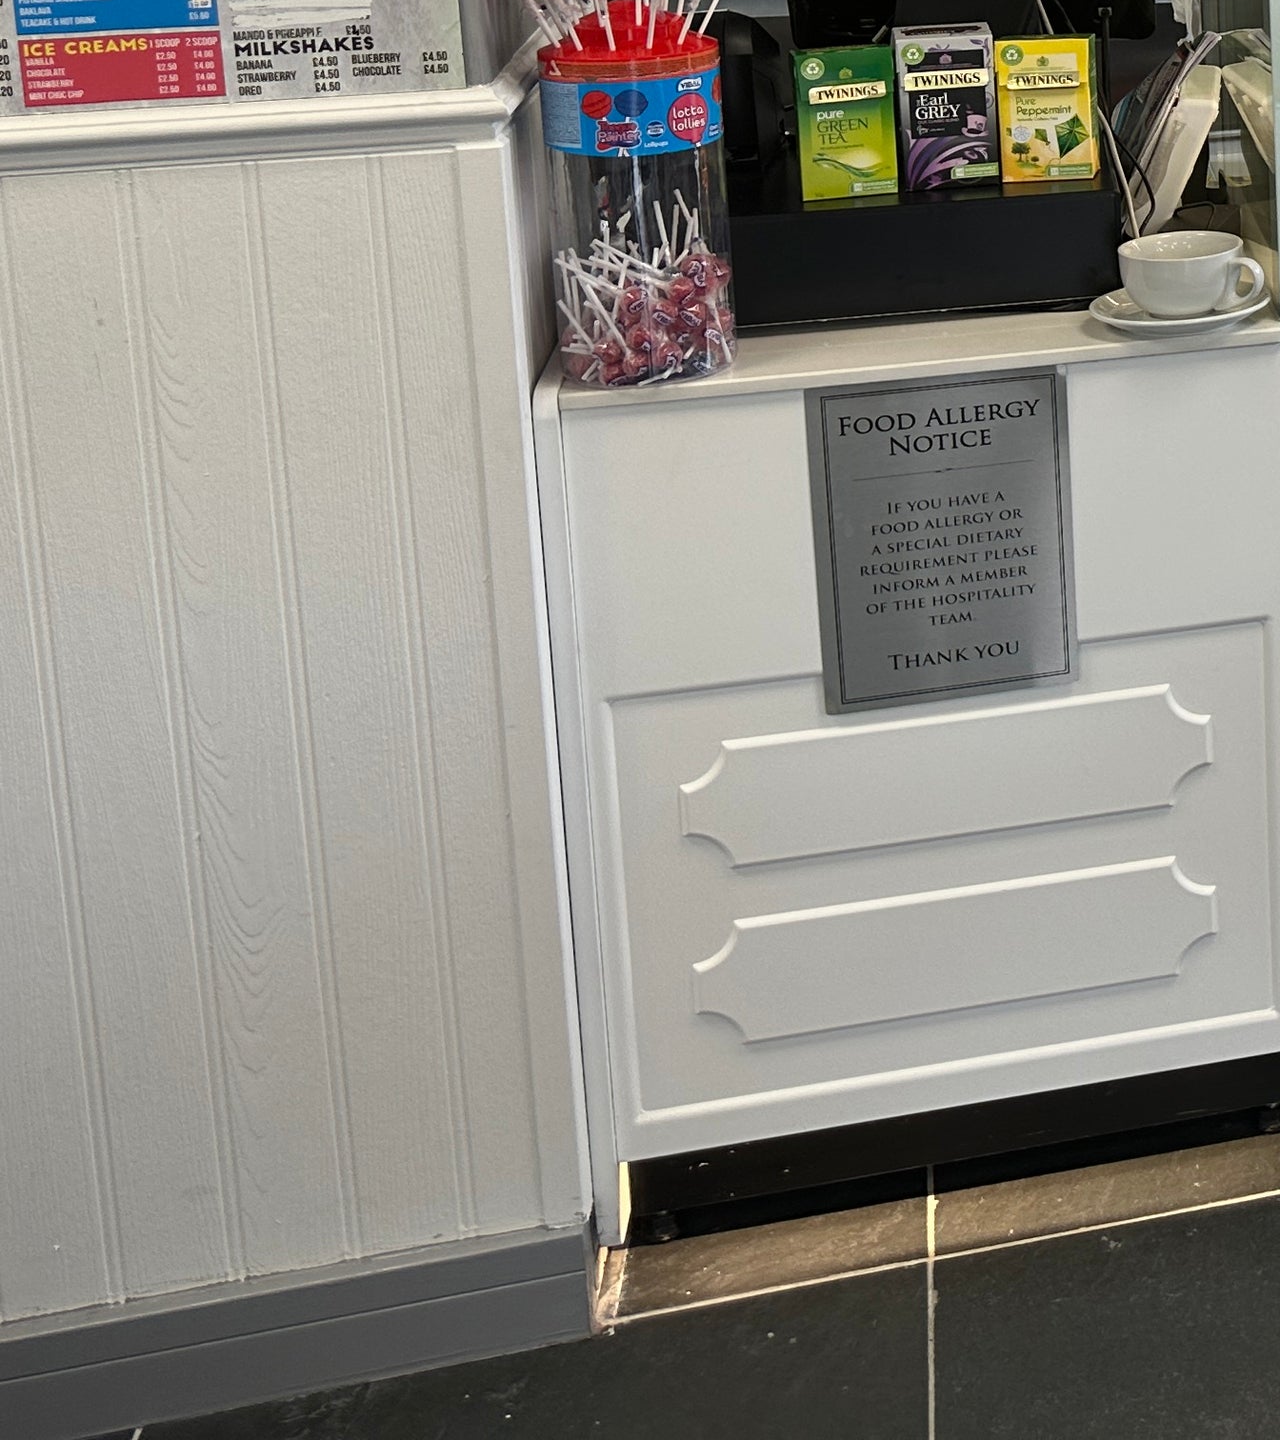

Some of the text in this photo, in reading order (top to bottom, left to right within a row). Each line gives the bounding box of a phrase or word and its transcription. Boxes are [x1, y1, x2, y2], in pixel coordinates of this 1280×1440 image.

[23, 38, 148, 57] ICE CREAMS
[234, 36, 374, 57] MILKSHAKES
[237, 56, 338, 71] BANANA £4.50
[352, 53, 401, 65] BLUEBERRY
[237, 69, 340, 84] STRAWBERRY £4.50
[353, 64, 448, 78] CHOCOLATE £4.50
[911, 72, 981, 87] TWININGS
[1013, 76, 1073, 86] TWININGS
[816, 85, 879, 101] TWININGS
[919, 92, 948, 106] Earl
[1015, 97, 1036, 106] Pure
[673, 106, 704, 119] lotta
[817, 109, 844, 120] pure
[915, 104, 960, 120] GREY
[1016, 105, 1072, 117] Peppermint
[673, 118, 705, 131] lollies
[817, 118, 868, 133] GREEN
[817, 131, 847, 145] TEA
[838, 399, 1041, 437] FOOD ALLERGY
[889, 429, 992, 457] NOTICE
[907, 498, 942, 512] YOU
[949, 494, 987, 507] HAVE
[990, 491, 1004, 503] A
[872, 508, 1023, 536] FOOD ALLERGY OR
[871, 528, 1024, 556] A SPECIAL DIETARY
[860, 545, 1038, 577] REQUIREMENT PLEASE
[873, 565, 1028, 595] INFORM A MEMBER
[866, 584, 1036, 615] OF THE HOSPITALITY
[888, 641, 1020, 671] THANK YOU
